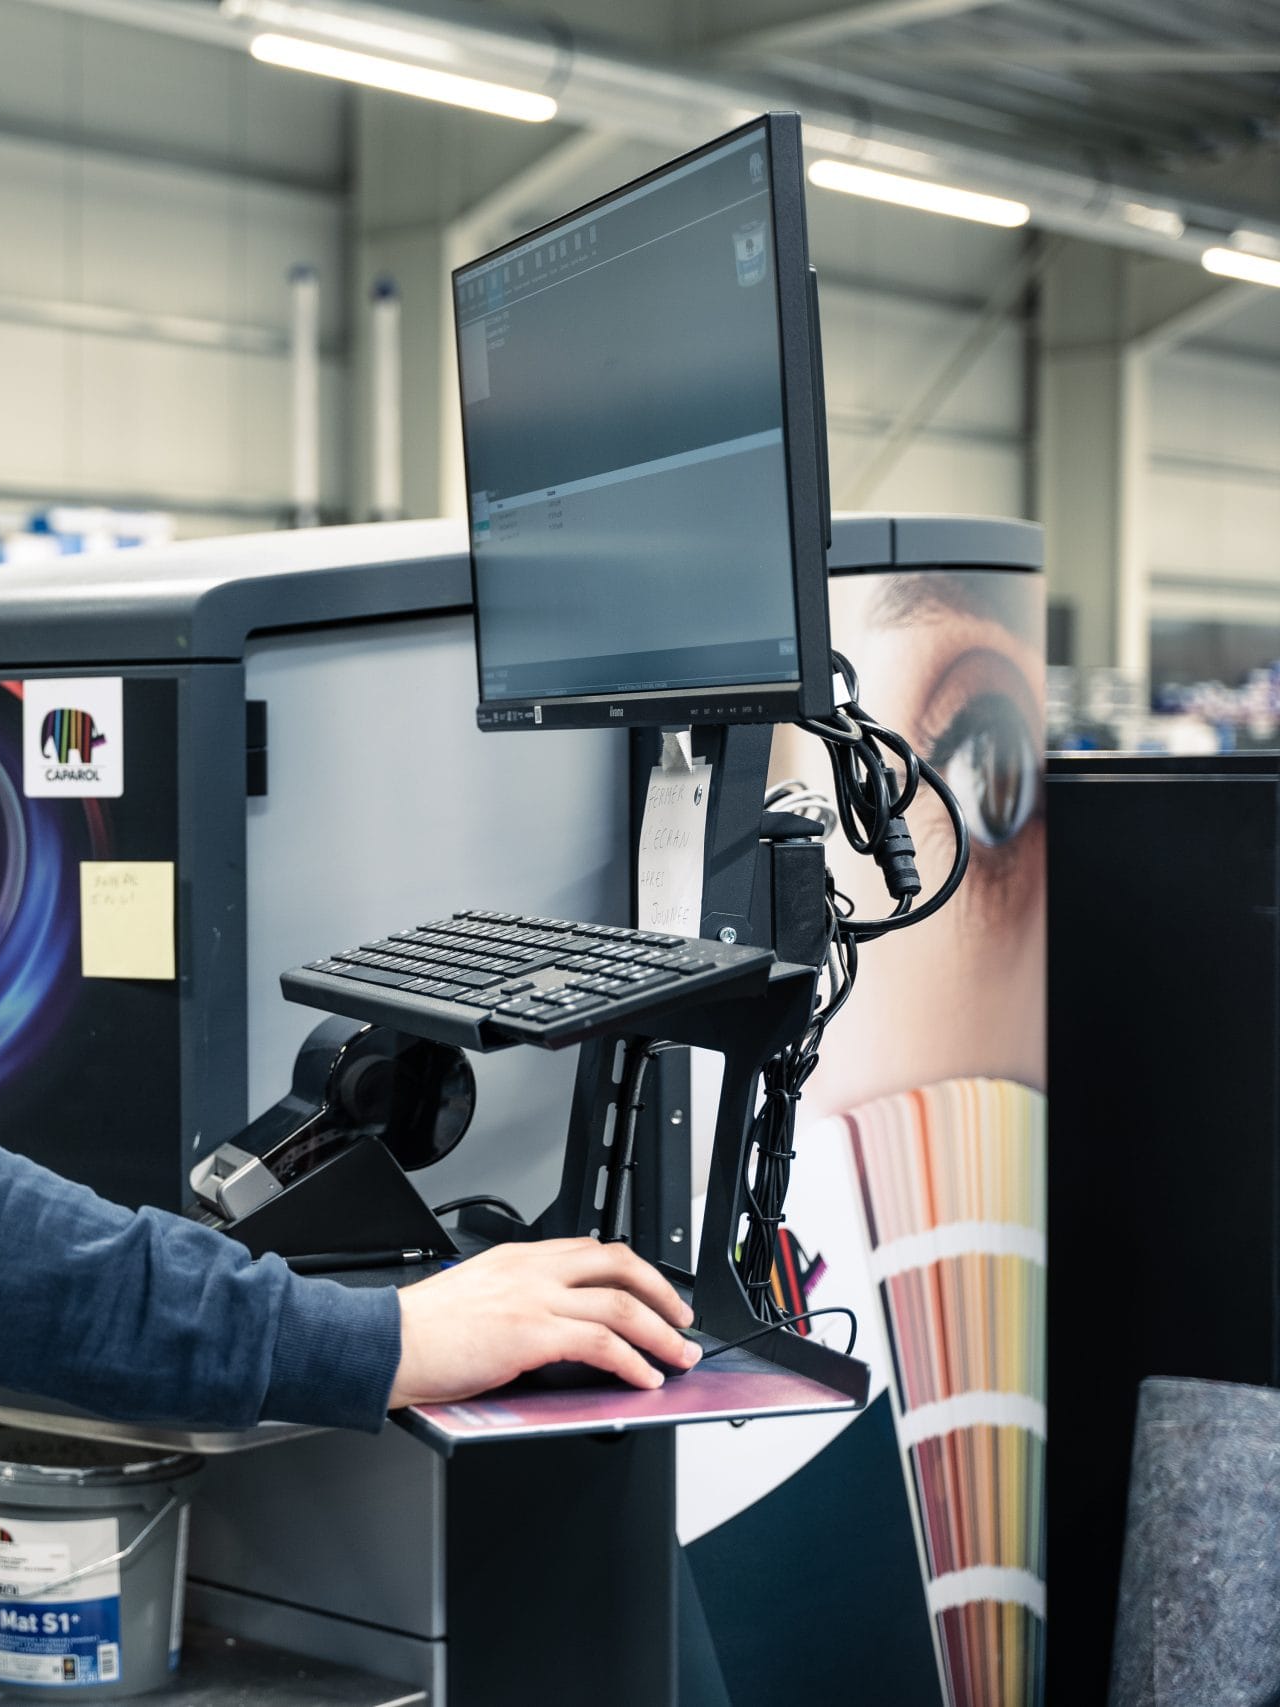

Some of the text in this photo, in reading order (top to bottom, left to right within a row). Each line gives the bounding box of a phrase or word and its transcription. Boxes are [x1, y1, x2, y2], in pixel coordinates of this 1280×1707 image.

[45, 768, 100, 781] CAPAROL
[648, 784, 685, 808] FERMER
[0, 1608, 38, 1633] Mat
